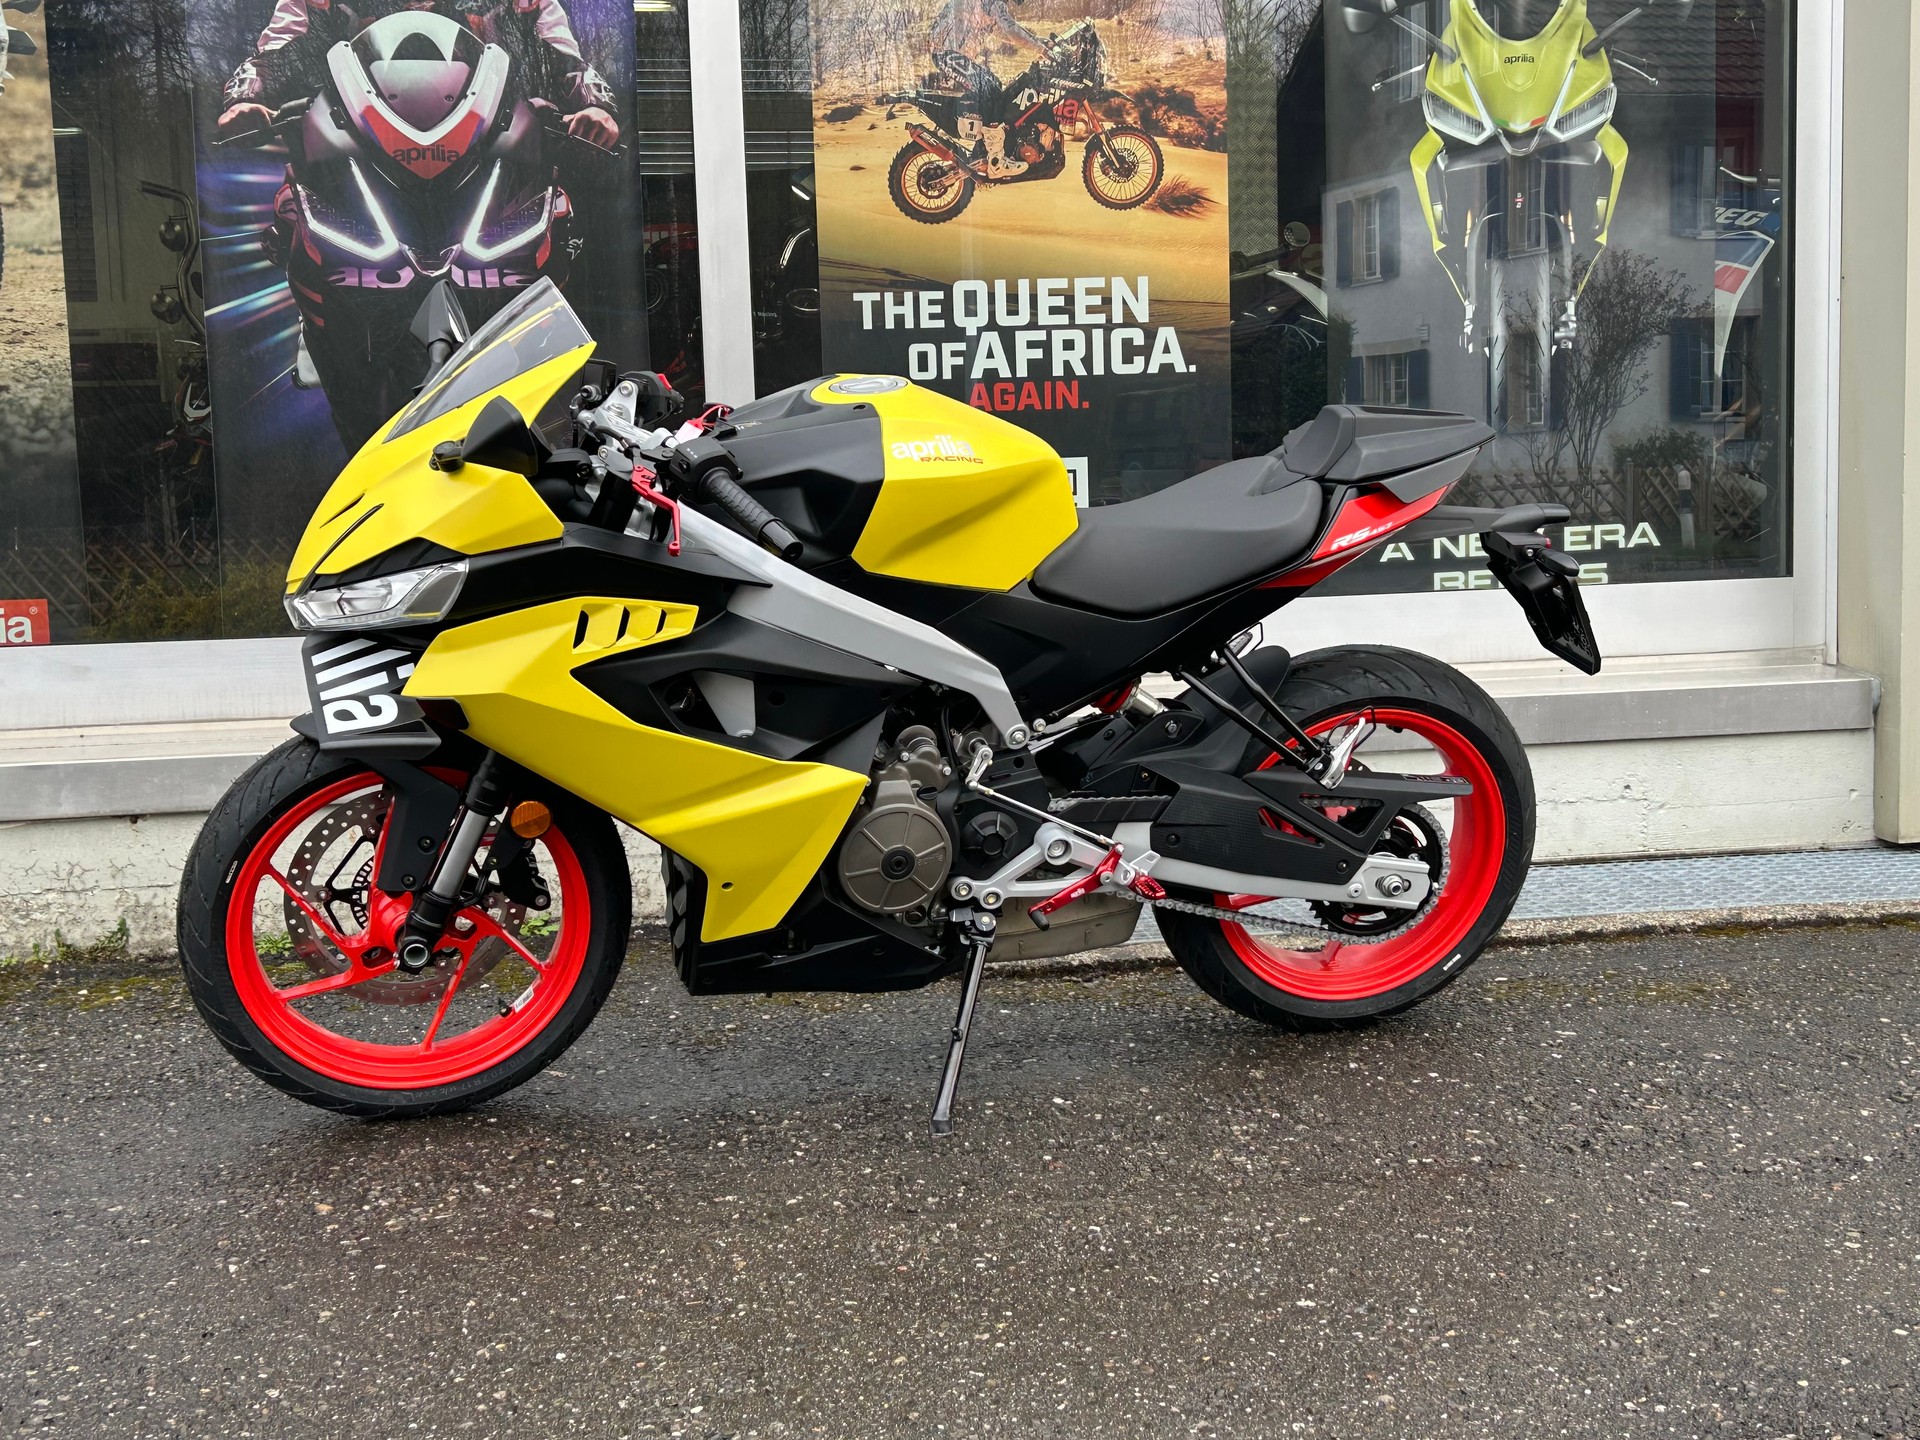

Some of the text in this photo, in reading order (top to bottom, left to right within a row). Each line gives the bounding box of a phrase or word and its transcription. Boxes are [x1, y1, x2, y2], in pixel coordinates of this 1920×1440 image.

[1503, 53, 1535, 65] aprilia
[392, 143, 461, 165] aprilia
[853, 275, 1149, 336] THE QUEEN
[908, 326, 1197, 381] OF AFRICA.
[970, 380, 1090, 412] AGAIN.
[891, 434, 974, 462] aprilia
[920, 455, 984, 465] RACING
[1379, 542, 1415, 562] A
[1563, 521, 1661, 551] ERA
